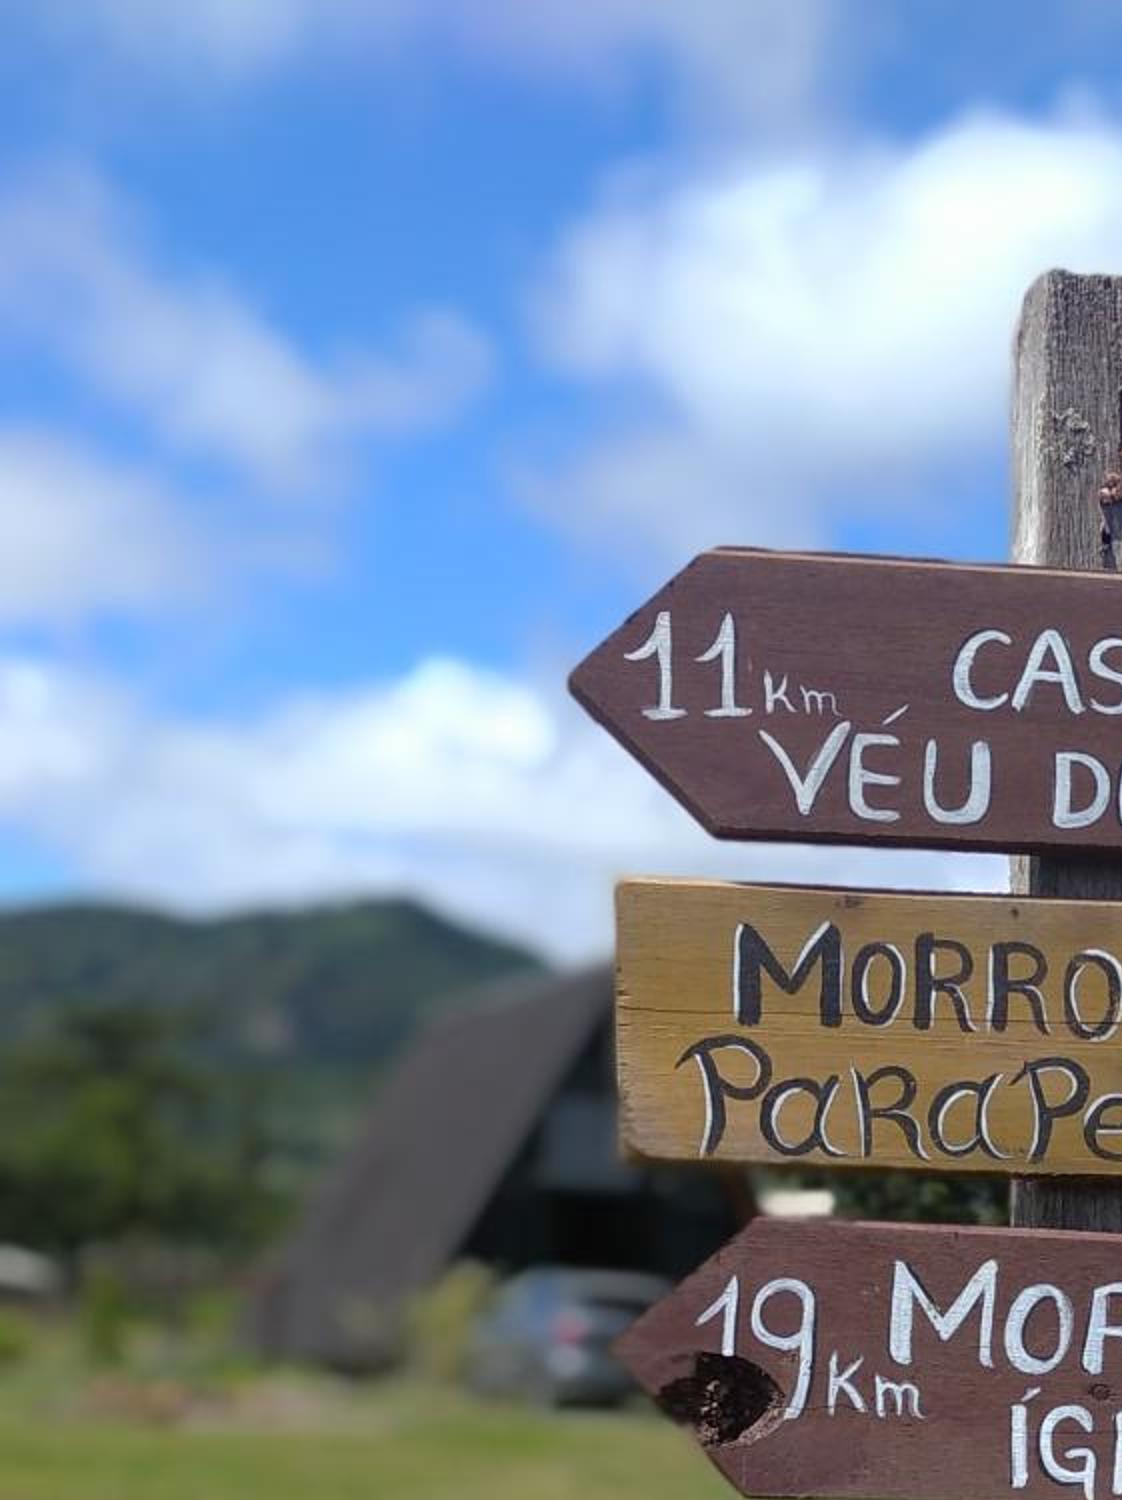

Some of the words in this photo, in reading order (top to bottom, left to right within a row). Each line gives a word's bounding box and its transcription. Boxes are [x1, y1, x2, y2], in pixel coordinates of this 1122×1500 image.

[623, 611, 756, 720] 11
[759, 703, 991, 825] VÉU
[695, 1274, 815, 1420] 19
